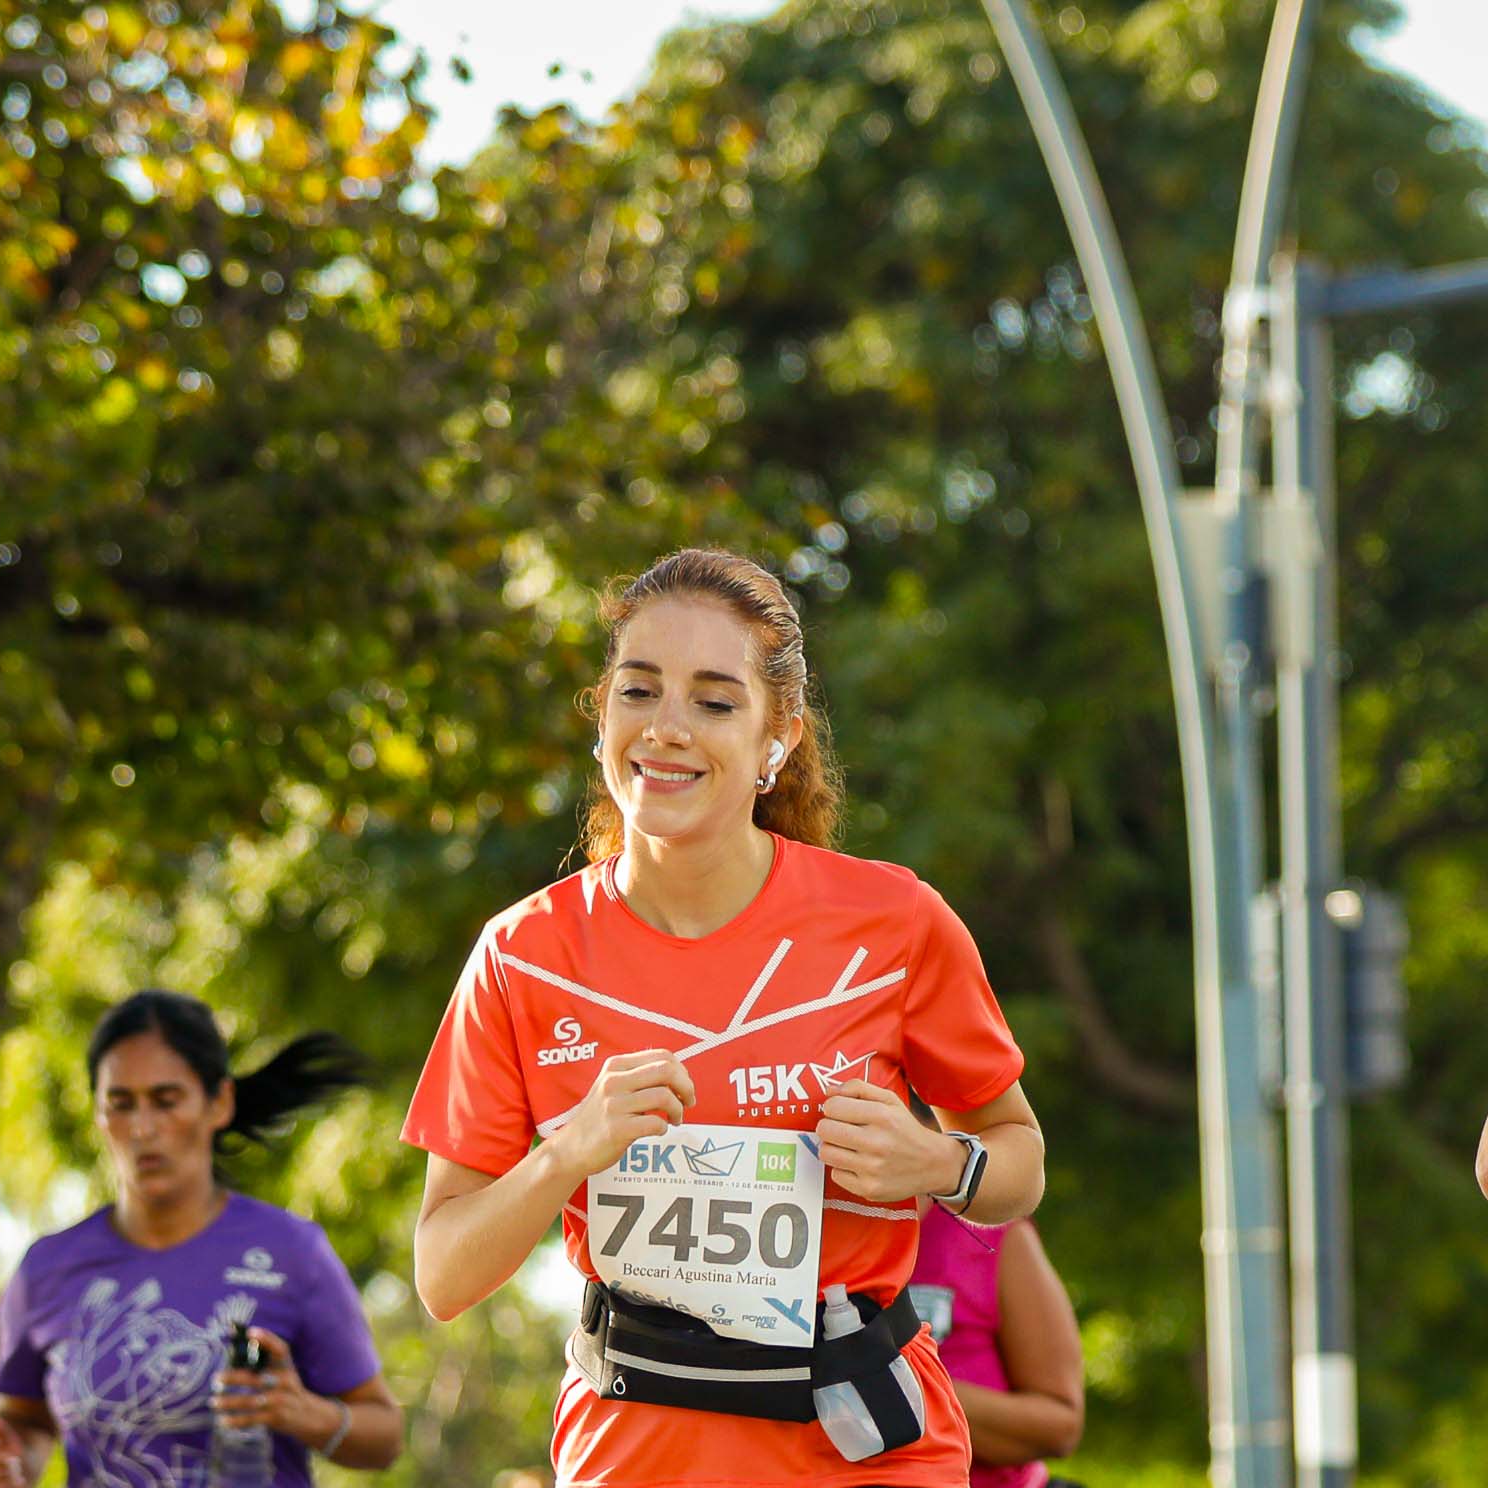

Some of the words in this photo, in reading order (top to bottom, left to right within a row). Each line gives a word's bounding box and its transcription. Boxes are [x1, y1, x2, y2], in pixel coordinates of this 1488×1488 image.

[728, 1063, 810, 1105] 15K
[738, 1103, 810, 1118] PUERTO
[761, 1153, 792, 1171] 10K
[613, 1176, 642, 1184] PUERTO
[693, 1179, 724, 1187] ROSARIO
[597, 1193, 809, 1269] 7450
[622, 1263, 670, 1279] Beccari
[674, 1266, 732, 1284] Agustina
[737, 1271, 777, 1286] María
